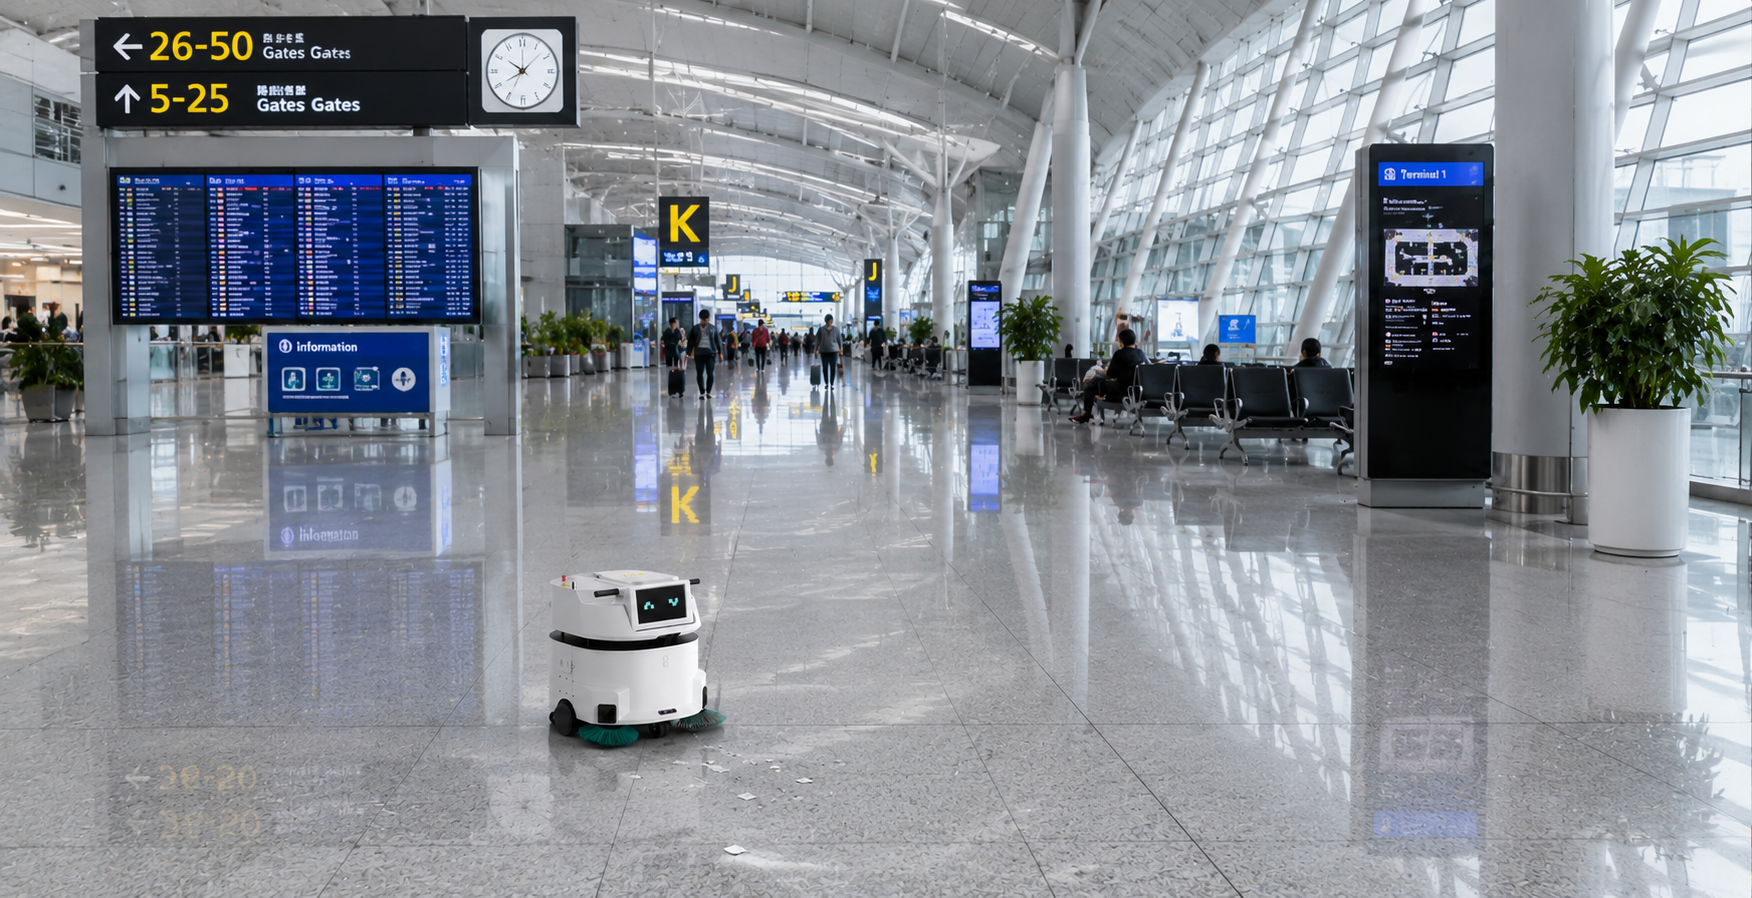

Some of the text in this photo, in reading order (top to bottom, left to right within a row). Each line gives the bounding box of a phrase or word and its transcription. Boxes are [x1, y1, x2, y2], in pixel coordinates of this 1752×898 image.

[149, 30, 254, 61] 26-50
[262, 45, 306, 60] Gates
[150, 83, 229, 114] 5-25
[256, 96, 361, 112] Gates Gates
[669, 204, 701, 243] K
[868, 261, 878, 282] J
[728, 275, 737, 293] J
